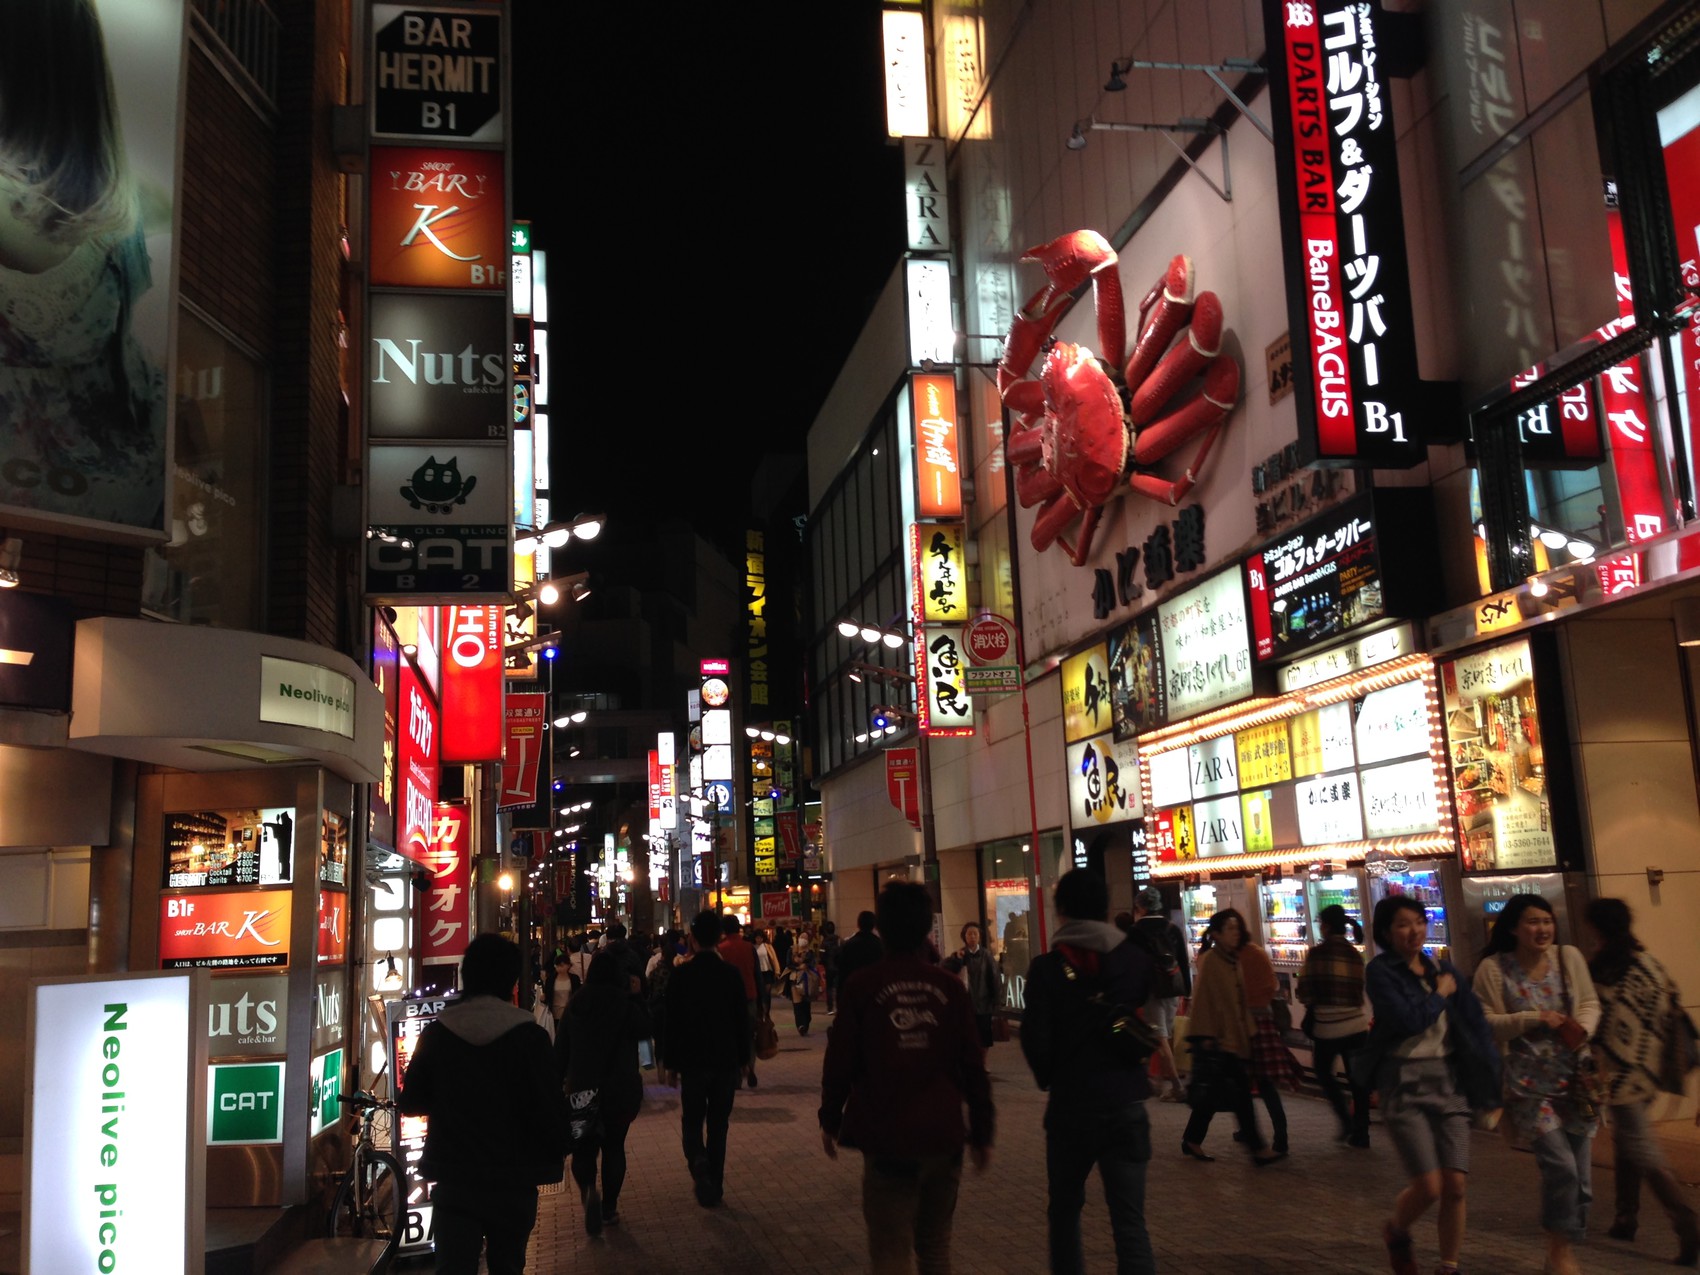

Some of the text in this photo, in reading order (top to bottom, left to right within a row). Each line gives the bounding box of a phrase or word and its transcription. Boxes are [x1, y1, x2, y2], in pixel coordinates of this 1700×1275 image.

[403, 16, 472, 48] BAR
[379, 51, 496, 94] HERMIT
[1357, 2, 1383, 130] シミュレーション
[421, 102, 457, 130] B1
[1292, 40, 1328, 210] DARTS BAR
[403, 172, 479, 199] BAR
[914, 142, 942, 246] ZARA
[1323, 8, 1388, 387] ゴルフ&ダーツバー
[400, 203, 483, 261] K
[1307, 238, 1349, 419] BaneBAGUS
[373, 338, 505, 385] Nuts
[488, 425, 506, 437] B2
[1363, 401, 1408, 443] B1
[414, 527, 507, 535] OLD BLIND
[369, 537, 506, 571] CAT
[396, 574, 480, 589] B 2
[1249, 569, 1265, 591] B1
[973, 632, 1007, 649] 消火栓
[929, 634, 969, 716] 魚民
[971, 671, 1012, 679] ブランドオフ
[279, 683, 334, 707] Neolive
[409, 686, 433, 757] カラオケ
[1254, 738, 1287, 761] 武蔵野館
[1081, 742, 1127, 818] 魚民
[1194, 756, 1234, 785] ZARA
[406, 777, 420, 834] BIG
[417, 795, 433, 847] ECHO
[1200, 817, 1240, 845] ZARA
[169, 872, 208, 887] HERMIT
[209, 868, 232, 877] Cocktail
[209, 876, 227, 884] Spirits
[429, 815, 461, 947] カラオケ
[167, 899, 194, 917] B1F
[193, 921, 234, 938] BAR
[235, 909, 281, 946] K
[316, 984, 340, 1029] Nuts
[1000, 973, 1026, 1009] AR
[209, 991, 277, 1036] uts
[405, 1001, 446, 1017] BAR
[238, 1034, 277, 1044] cafe&bar
[220, 1092, 274, 1111] CAT
[94, 1003, 128, 1275] Neolive pico
